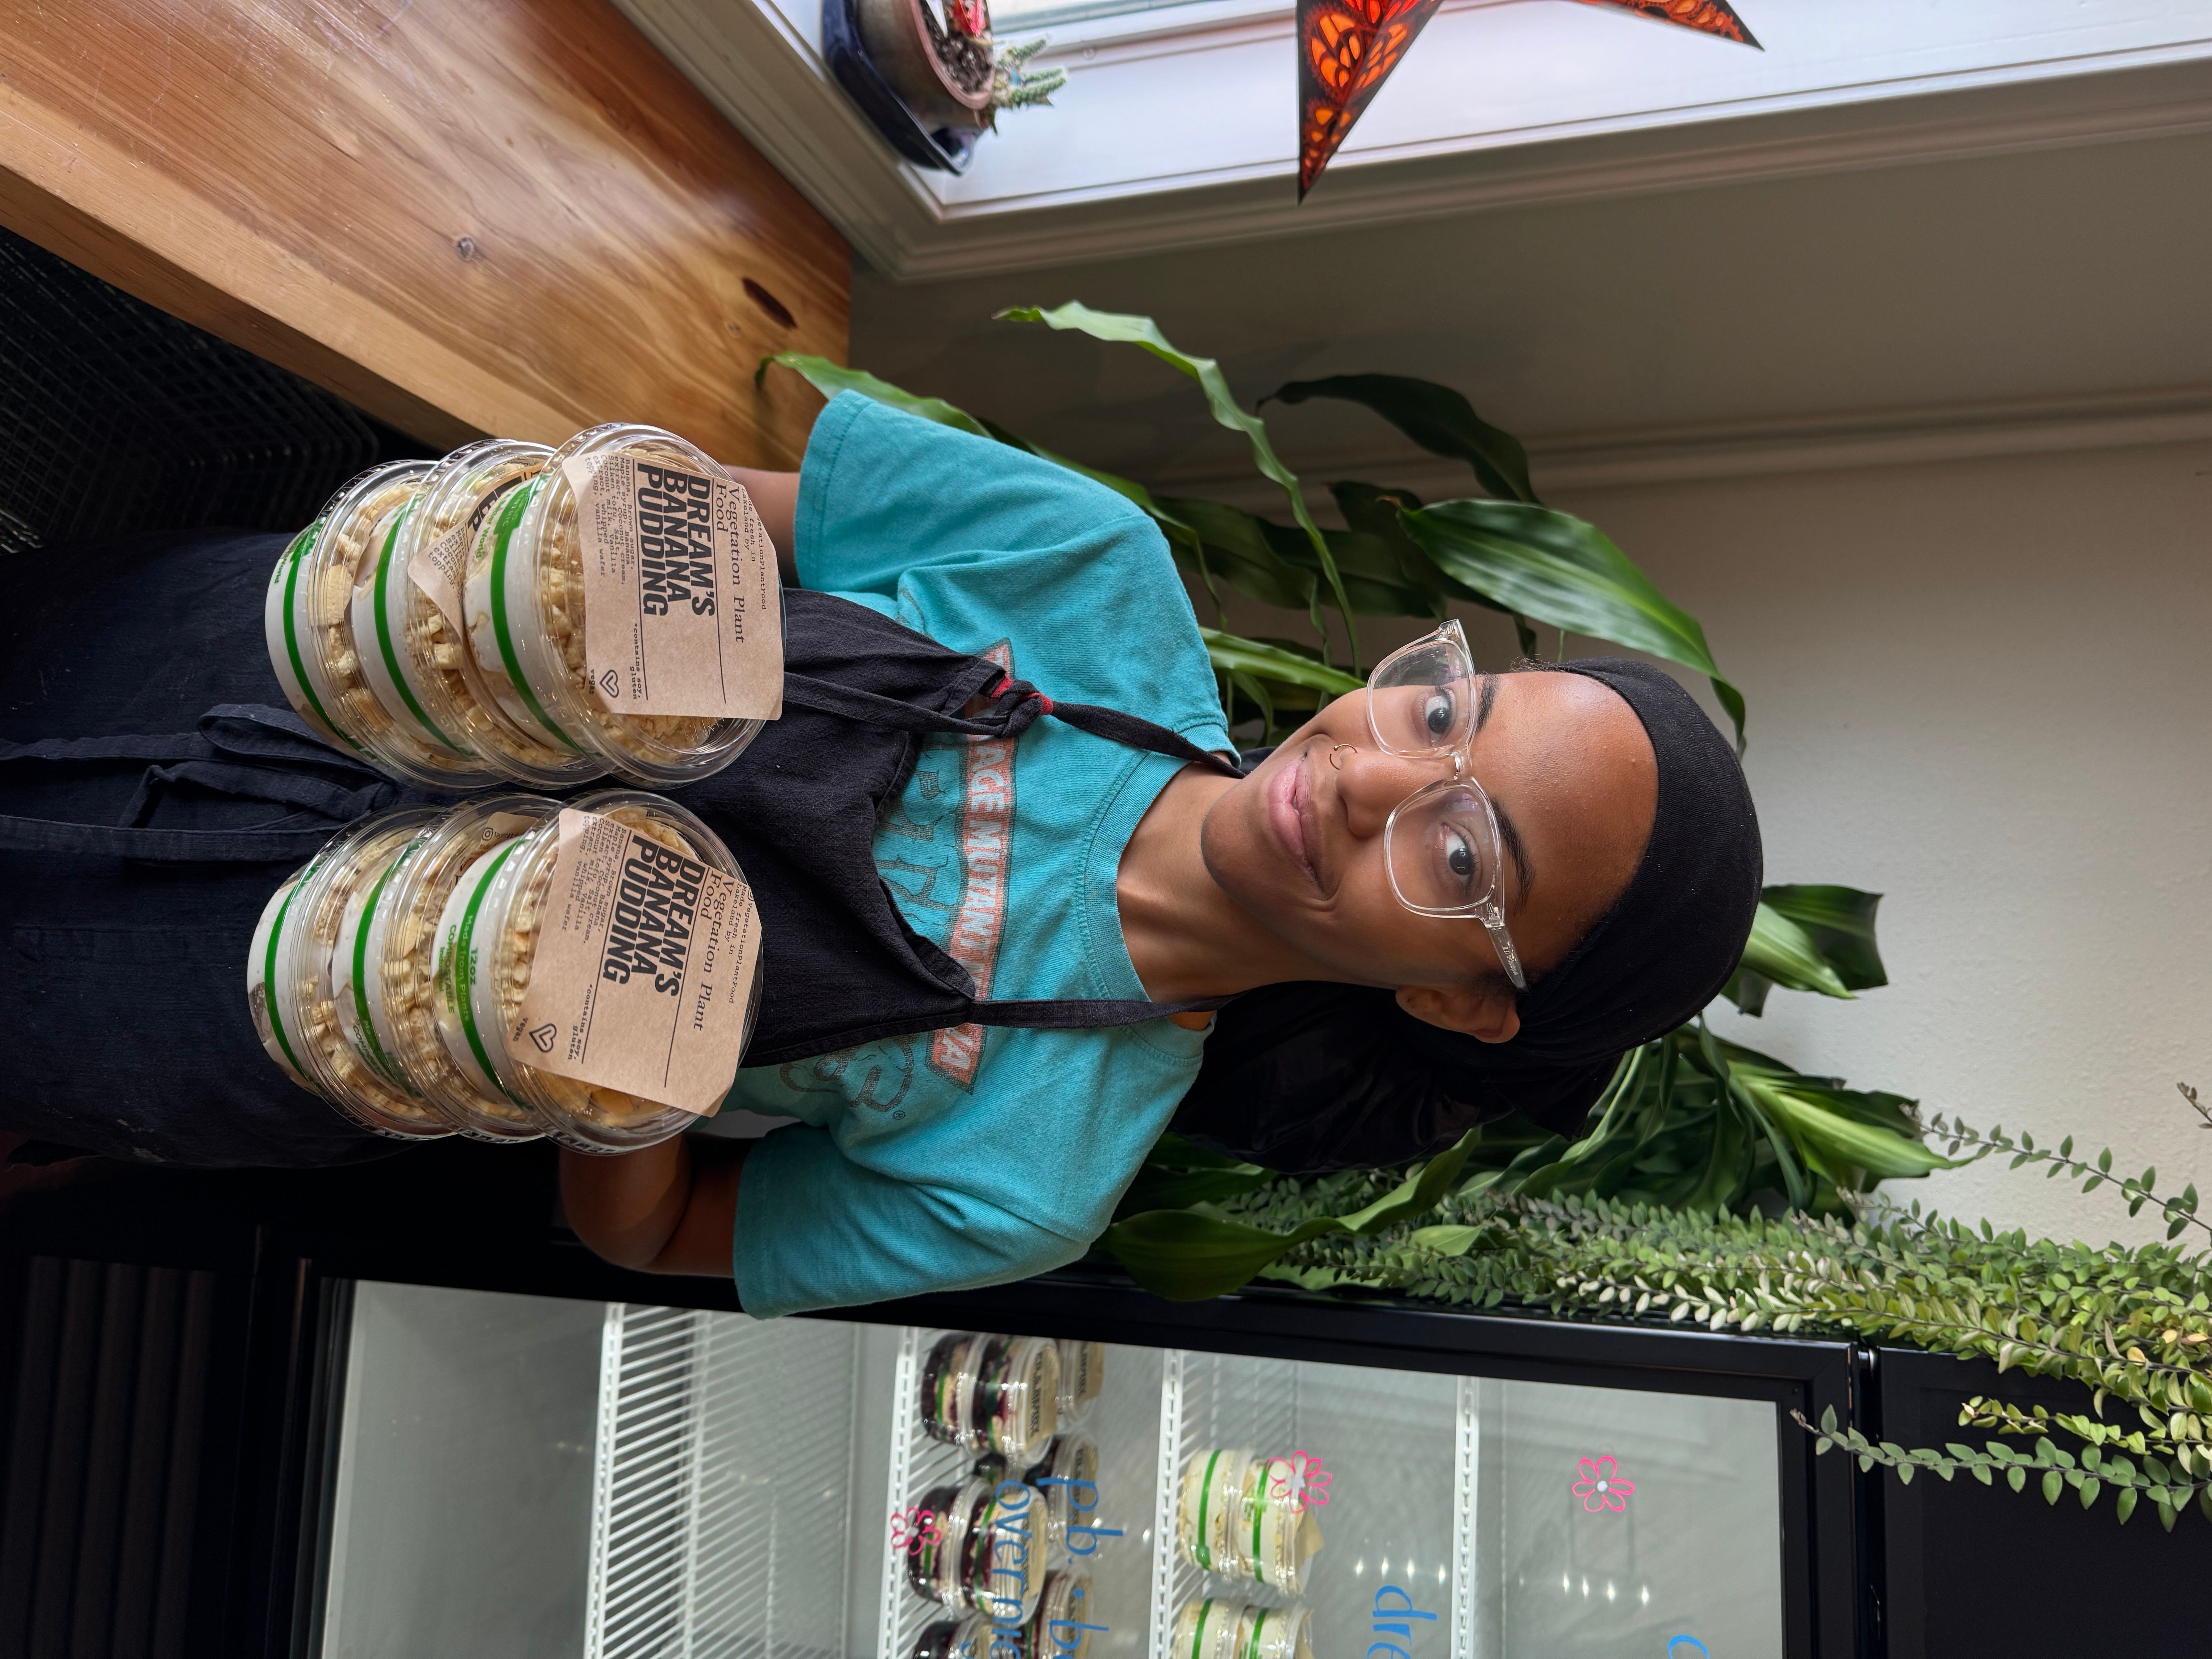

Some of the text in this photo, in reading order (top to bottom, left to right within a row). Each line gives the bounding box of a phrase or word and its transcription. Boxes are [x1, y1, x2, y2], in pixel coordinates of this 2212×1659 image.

[585, 458, 599, 495] topping,
[601, 455, 610, 493] Coconut
[716, 482, 728, 532] Food
[476, 526, 491, 558] World
[601, 504, 609, 544] whipped
[637, 463, 668, 616] PUDDING
[663, 469, 691, 602] BANANA
[687, 475, 715, 616] DREAM'S
[744, 539, 750, 550] by
[751, 551, 756, 562] in
[726, 486, 745, 643] Vegetation Plant
[630, 666, 638, 699] gluten
[562, 816, 591, 932] topping, vanilla wafer
[575, 816, 598, 902] extract, whipped
[575, 818, 605, 930] Coconut milk, Vanilla
[583, 823, 615, 944] extract, Coconut cream,
[584, 820, 610, 914] Silken tofu, Salt,
[594, 825, 621, 926] Maple syrup, Banana
[598, 828, 627, 932] Banana, Brown sugar,
[960, 821, 1005, 955] MUTANT
[602, 835, 659, 984] PUDDING
[631, 846, 683, 975] BANANA
[654, 857, 706, 997] DREAM'S
[699, 871, 722, 920] Food
[725, 883, 742, 942] Lakeland by
[729, 885, 747, 955] Made fresh in
[461, 915, 473, 947] Made
[694, 880, 735, 1031] Vegetation Plant
[445, 924, 457, 1013] COMPOSTABLE
[470, 948, 478, 986] 12oz
[460, 984, 470, 1022] Plants
[513, 1018, 529, 1042] vegan
[568, 1025, 578, 1060] gluten
[574, 1039, 582, 1060] soy,
[1049, 1619, 1109, 1659] b
